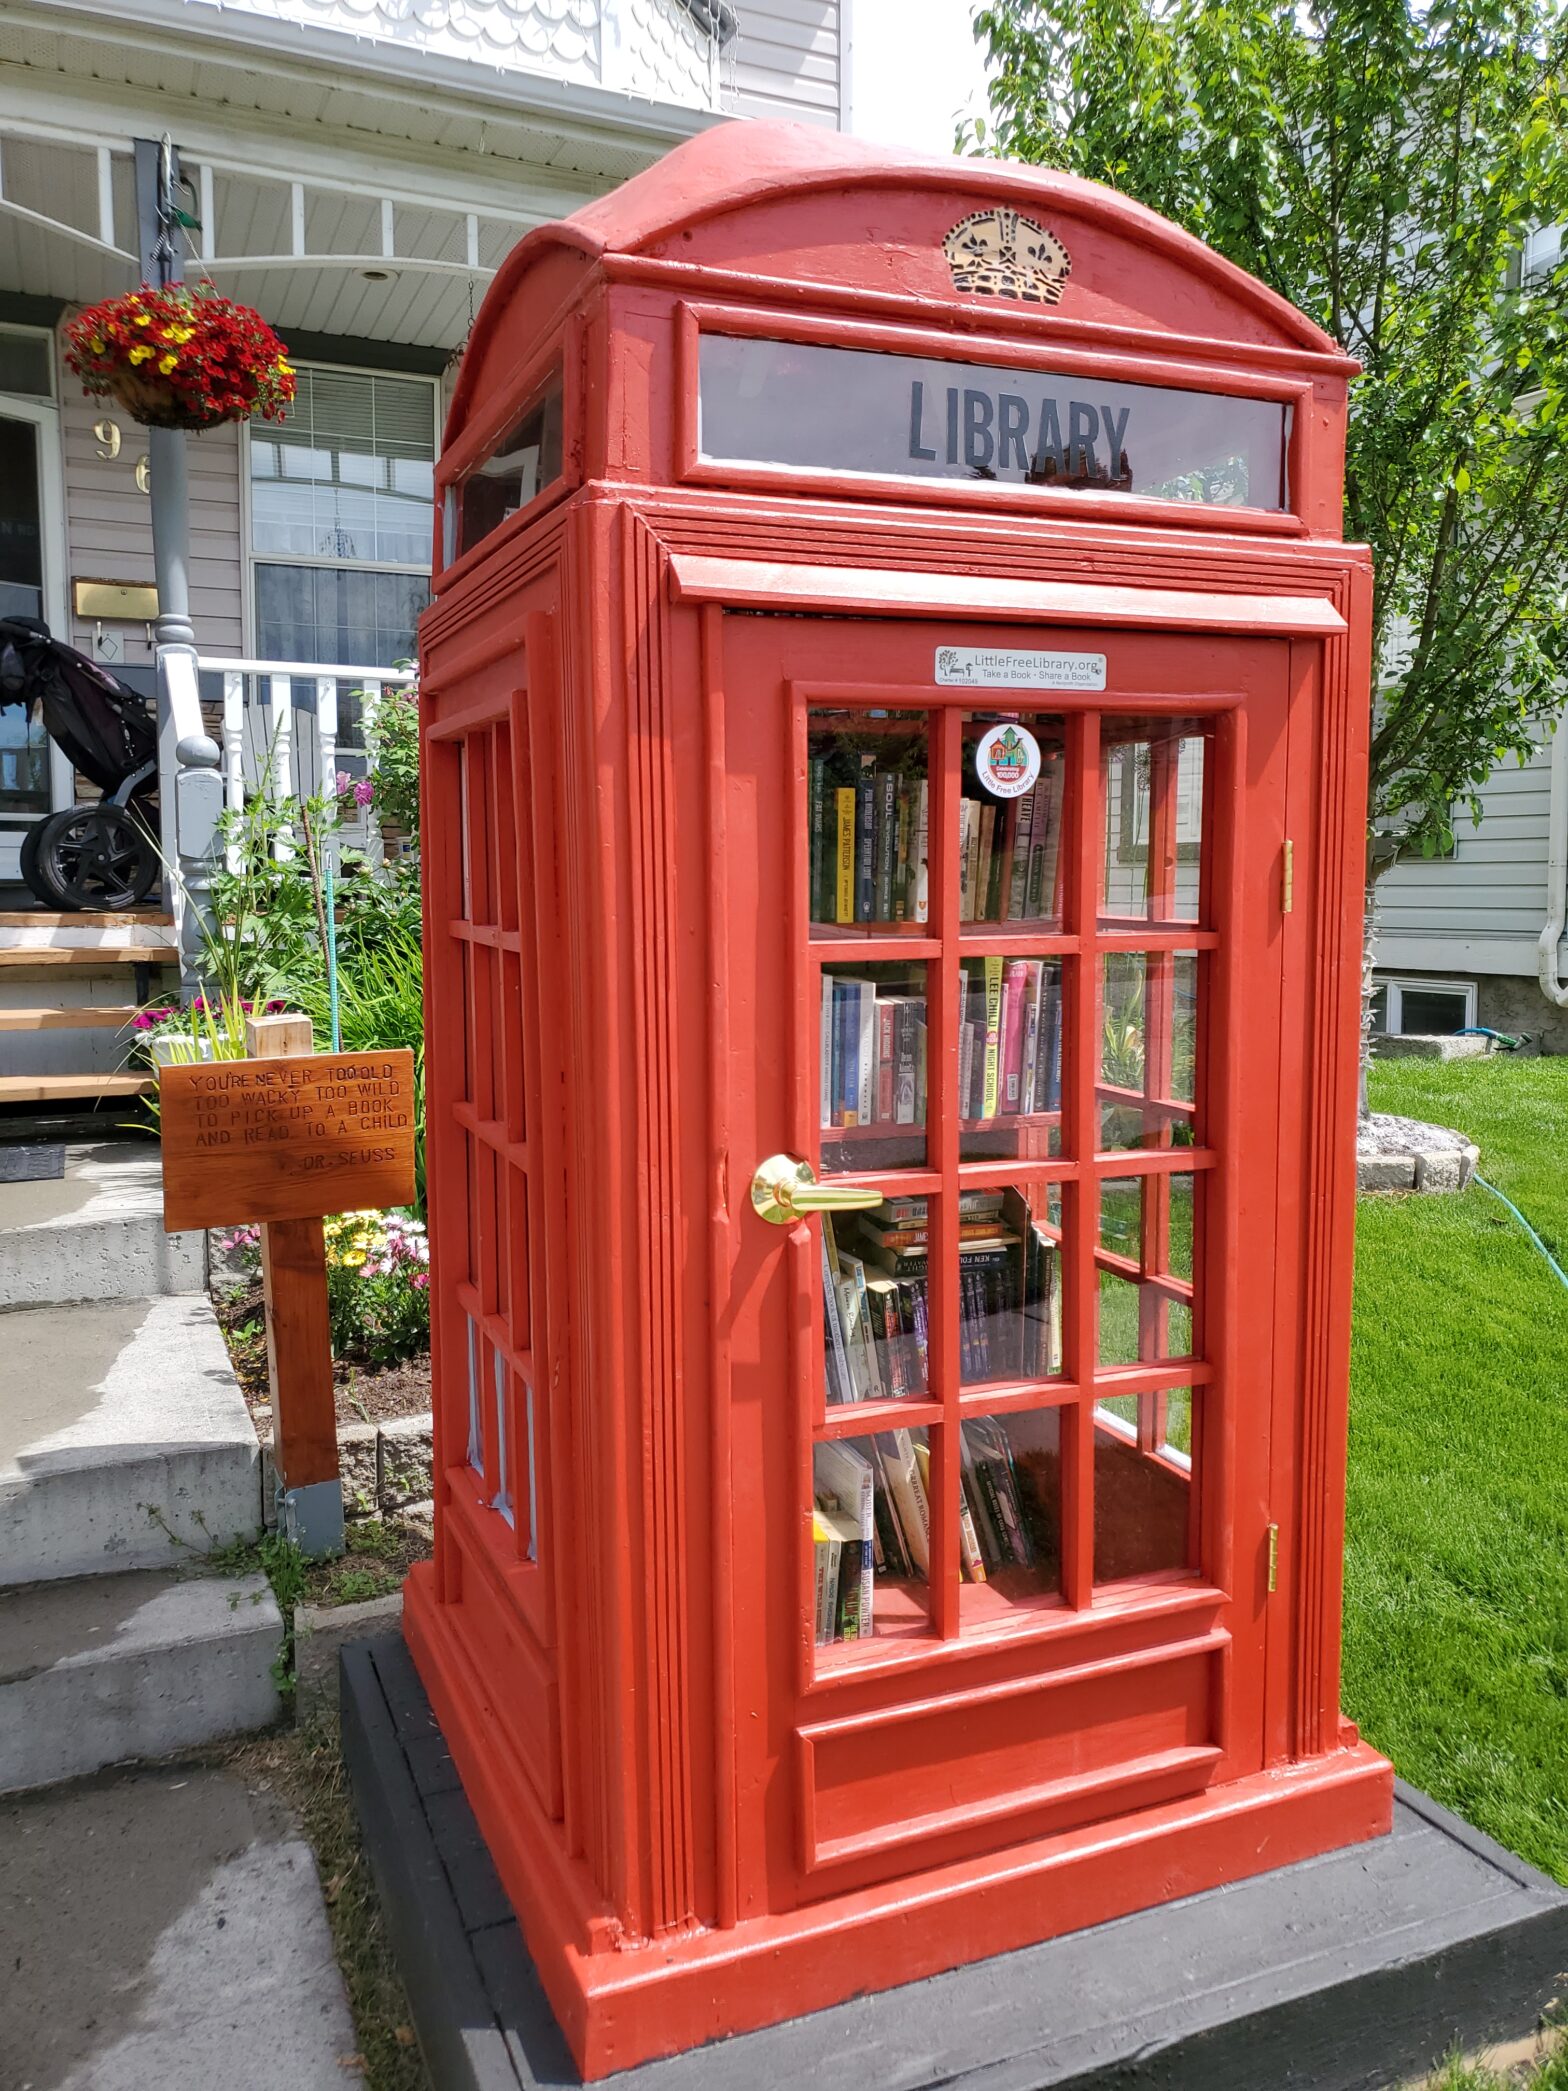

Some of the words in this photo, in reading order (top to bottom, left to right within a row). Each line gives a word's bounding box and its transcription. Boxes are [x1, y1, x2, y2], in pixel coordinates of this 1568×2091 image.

[94, 418, 122, 460] 9
[910, 381, 1130, 480] LIBRARY
[975, 655, 1098, 674] LittleFreeLibrary.org
[983, 669, 1001, 678] Take
[1011, 670, 1031, 679] Book
[1039, 671, 1062, 680] Share
[1072, 672, 1091, 681] Book
[982, 771, 996, 789] Little
[996, 784, 1012, 794] Free
[1013, 773, 1035, 793] Library
[843, 817, 851, 837] JAMES
[843, 838, 851, 871] PATTERSON
[990, 977, 998, 994] LEE
[989, 998, 998, 1027] CHILD
[883, 1018, 891, 1033] JACK
[883, 1034, 891, 1058] HIGGINS
[987, 1049, 995, 1071] NIGHT
[189, 1072, 248, 1090] YOU'RE
[255, 1070, 313, 1087] NEVER
[327, 1065, 357, 1083] TOO
[360, 1064, 393, 1079] OLD
[986, 1073, 994, 1102] SCHOOL
[193, 1094, 230, 1111] TOO
[240, 1090, 302, 1106] WACKY
[316, 1085, 347, 1101] TOO
[357, 1082, 400, 1096] WILD
[195, 1113, 217, 1129] TO
[231, 1109, 277, 1126] PICK
[290, 1106, 313, 1120] UP
[326, 1106, 336, 1118] A
[348, 1098, 394, 1116] BOOK
[196, 1130, 231, 1147] AND
[244, 1125, 289, 1144] READ
[306, 1121, 326, 1137] TO
[338, 1120, 348, 1135] A
[360, 1114, 407, 1131] CHILD
[338, 1147, 395, 1166] SEUSS
[861, 1571, 870, 1595] SUSAN
[861, 1597, 870, 1628] POWTER
